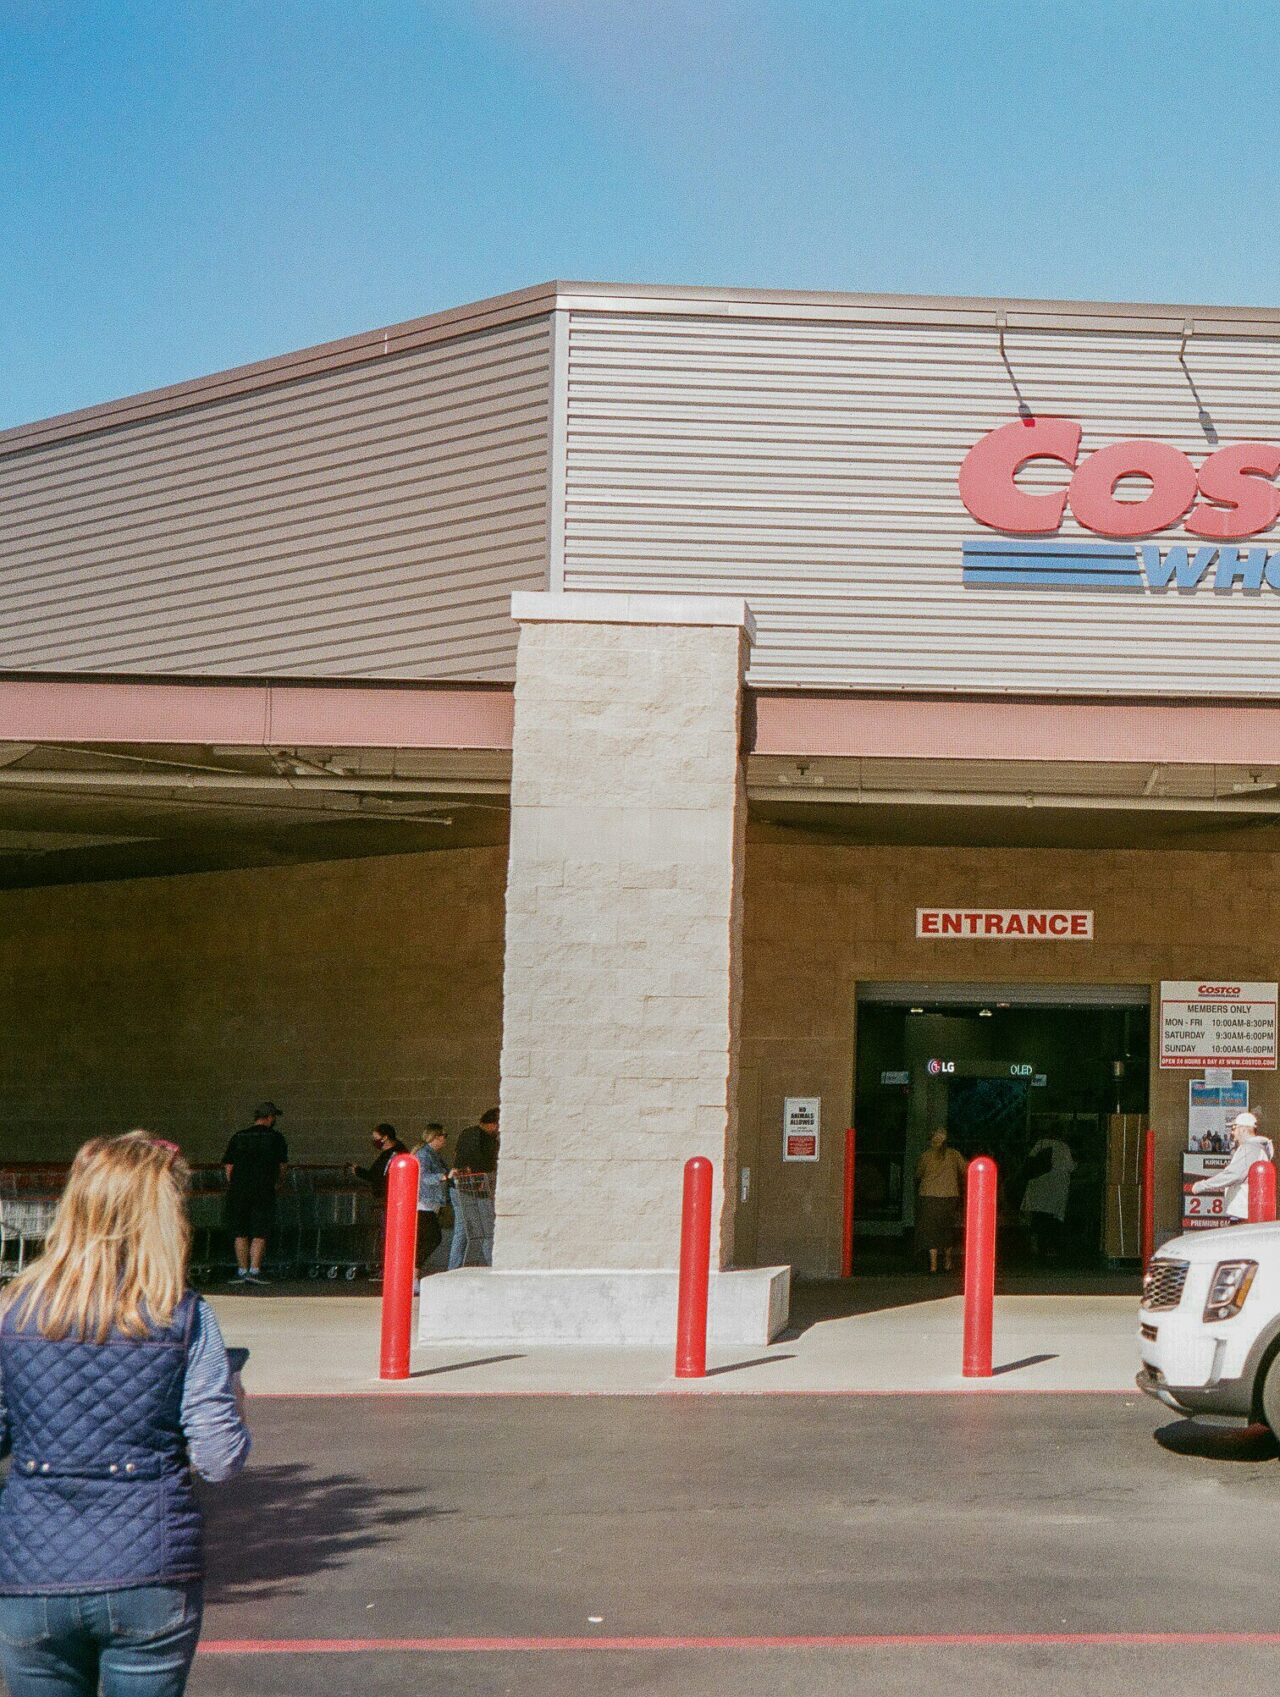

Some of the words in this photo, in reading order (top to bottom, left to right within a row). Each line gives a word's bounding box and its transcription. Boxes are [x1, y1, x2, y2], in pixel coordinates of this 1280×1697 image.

[922, 913, 1088, 935] ENTRANCE
[1198, 985, 1240, 994] COSTCO
[1187, 1004, 1228, 1013] MEMBERS
[1230, 1005, 1252, 1014] ONLY
[1165, 1018, 1184, 1026] MON
[1212, 1020, 1274, 1028] 10:00AM-8:30PM
[1164, 1031, 1206, 1039] SATURDAY
[1215, 1032, 1274, 1040] 9:30AM-6:00PM
[1164, 1044, 1197, 1052] SUNDAY
[1212, 1045, 1274, 1053] 10:00AM-6:00PM
[942, 1062, 955, 1073] LG
[1010, 1064, 1033, 1076] OLED
